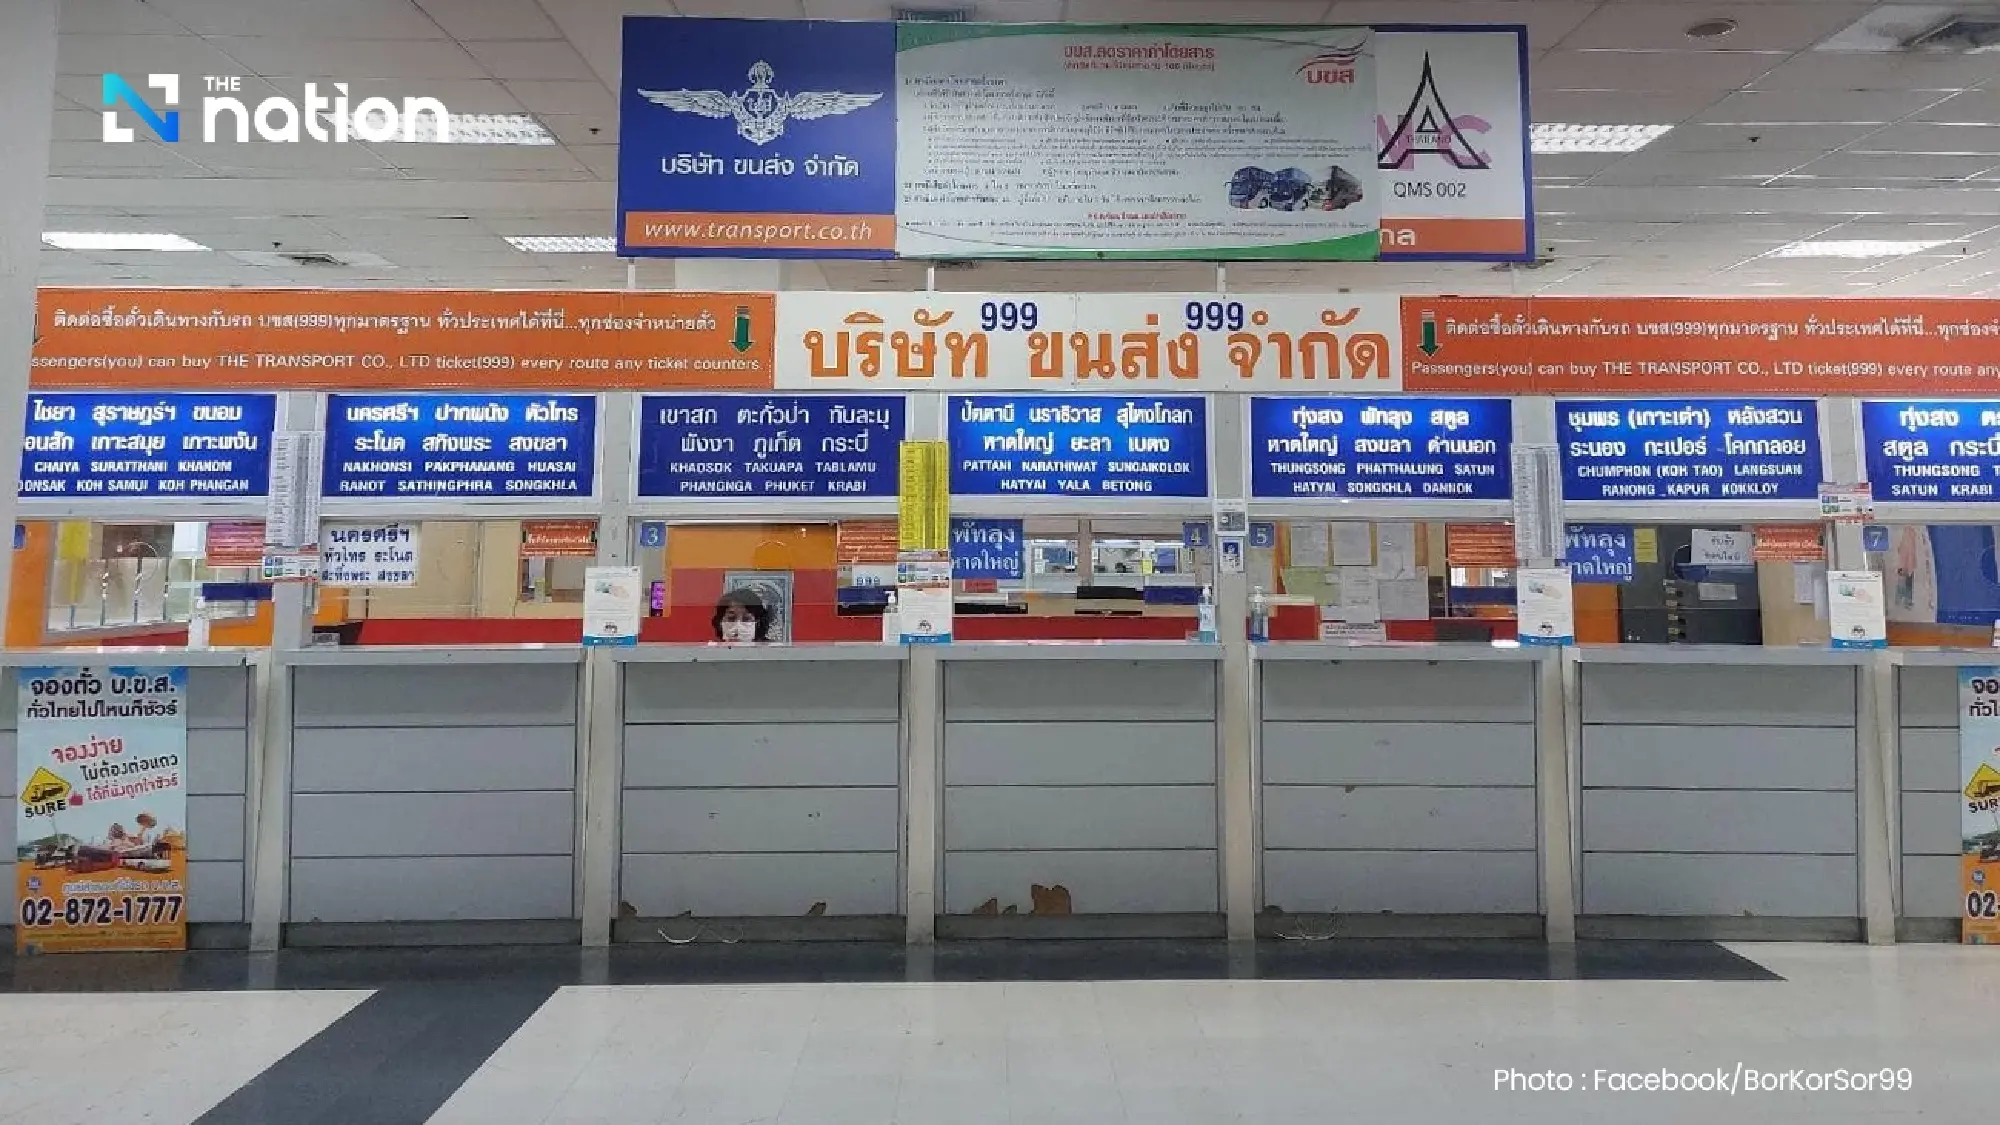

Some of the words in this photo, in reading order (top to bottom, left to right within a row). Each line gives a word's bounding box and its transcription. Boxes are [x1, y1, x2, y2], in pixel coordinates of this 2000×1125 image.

[661, 152, 724, 175] บริษัท
[735, 153, 795, 175] ขนส่ง
[804, 154, 860, 176] จำกัด
[1394, 182, 1432, 198] QMS
[1437, 182, 1467, 198] 002
[645, 219, 872, 242] www.transport.co.th
[980, 302, 1039, 332] 999
[1185, 302, 1244, 332] 999
[803, 308, 990, 379] บริษัท
[1028, 312, 1201, 379] ขนส่ง
[1226, 307, 1391, 379] จำกัด
[149, 357, 176, 368] can
[182, 355, 211, 370] buy
[219, 355, 249, 368] THE
[255, 355, 353, 368] TRANSPORT
[399, 356, 430, 368] LTD
[436, 356, 516, 370] ticket(999)
[521, 358, 564, 371] every
[569, 358, 610, 370] route
[614, 360, 644, 372] any
[648, 358, 688, 370] ticket
[1411, 361, 1533, 378] Passengers(you)
[1537, 364, 1564, 375] can
[1570, 362, 1598, 378] buy
[1602, 361, 1633, 375] THE
[1639, 361, 1731, 376] TRANSPORT
[1773, 362, 1804, 375] LTD
[1808, 362, 1883, 377] ticket(999)
[1888, 365, 1928, 378] every
[1933, 364, 1973, 376] route
[33, 399, 76, 421] ไชยา
[192, 404, 243, 421] ขนอม
[346, 402, 419, 422] นครศรีฯ
[435, 402, 510, 422] ปากพนัง
[525, 400, 579, 422] หัวไทร
[659, 407, 718, 425] เขาสก
[737, 400, 810, 425] ตะกั่วป่า
[830, 404, 890, 430] ทับละมุ
[961, 399, 1016, 423] ปัตตานี
[1028, 404, 1103, 424] นราธิวาส
[1291, 405, 1344, 430] ทุ่งสง
[1360, 406, 1413, 430] พัทลุง
[1430, 407, 1470, 430] สตูล
[1568, 410, 1621, 433] ชุมพร
[1628, 405, 1712, 430] (เกาะเต่า)
[1727, 405, 1803, 426] หลังสวน
[1900, 405, 1960, 433] ทุ่งสง
[91, 434, 166, 457] เกาะสมุย
[354, 429, 406, 452] ระโนด
[508, 434, 568, 452] สงขลา
[681, 432, 734, 452] พังงา
[753, 431, 801, 459] ภูเก็ต
[821, 429, 869, 453] กระบี่
[983, 428, 1055, 455] หาดใหญ่
[1070, 435, 1112, 452] ยะลา
[1128, 435, 1170, 453] เบตง
[1267, 431, 1339, 457] หาดใหญ่
[1354, 437, 1412, 454] สงขลา
[1428, 435, 1497, 455] ด่านนอก
[1570, 440, 1627, 457] ระนอง
[1644, 435, 1707, 457] กะเปอร์
[1883, 439, 1929, 462] สตูล
[34, 460, 81, 473] CHAIYA
[91, 461, 168, 473] SURATTHANI
[178, 460, 233, 472] KHANOM
[343, 461, 413, 472] NAKHONSI
[424, 461, 516, 472] PAKPHANANG
[527, 461, 576, 473] HUASAI
[670, 462, 733, 473] KHAOSOK
[744, 462, 804, 473] TAKUAPA
[814, 462, 877, 473] TABLAMU
[962, 460, 1012, 471] PATTANI
[1022, 461, 1098, 472] NARATHIWAT
[1107, 461, 1191, 473] SUNGAIKOLOK
[1271, 462, 1347, 475] THUNGSONG
[1356, 463, 1444, 475] PHATTHALUNG
[1454, 463, 1495, 476] SATUN
[1577, 464, 1652, 477] CHUMPHON
[1656, 464, 1689, 479] (KOH
[1691, 464, 1724, 478] TAO)
[1734, 463, 1803, 476] LANGSUAN
[1893, 464, 1981, 477] THUNGSONG
[76, 479, 103, 492] KOH
[107, 479, 149, 491] SAMUI
[158, 479, 184, 492] KOH
[190, 479, 249, 491] PHANGAN
[339, 479, 386, 492] RANOT
[397, 479, 493, 492] SATHINGPHRA
[505, 479, 578, 491] SONGKHLA
[680, 481, 753, 492] PHANGNGA
[765, 481, 816, 492] PHUKET
[827, 481, 867, 492] KRABI
[1001, 479, 1047, 490] HATYAI
[1058, 479, 1091, 490] YALA
[1102, 479, 1153, 491] BETONG
[1293, 481, 1336, 493] HATYAI
[1347, 482, 1412, 493] SONGKHLA
[1422, 482, 1473, 493] DANNOK
[1602, 484, 1656, 496] RANONG
[1721, 483, 1779, 496] KOKKLOY
[1891, 484, 1938, 497] SATUN
[1951, 484, 1993, 496] KRABI
[648, 527, 659, 545] 3
[953, 521, 1015, 550] พัทลุง
[1190, 528, 1203, 544] 4
[1256, 527, 1267, 544] 5
[1565, 525, 1626, 557] พัทลุง
[1870, 530, 1881, 547] 7
[31, 667, 101, 695] จองตั๋ว
[111, 676, 176, 695] บ.ข.ส.
[51, 735, 124, 764] จองง่าย
[25, 799, 67, 818] SURE
[21, 896, 183, 925] 02-872-1777
